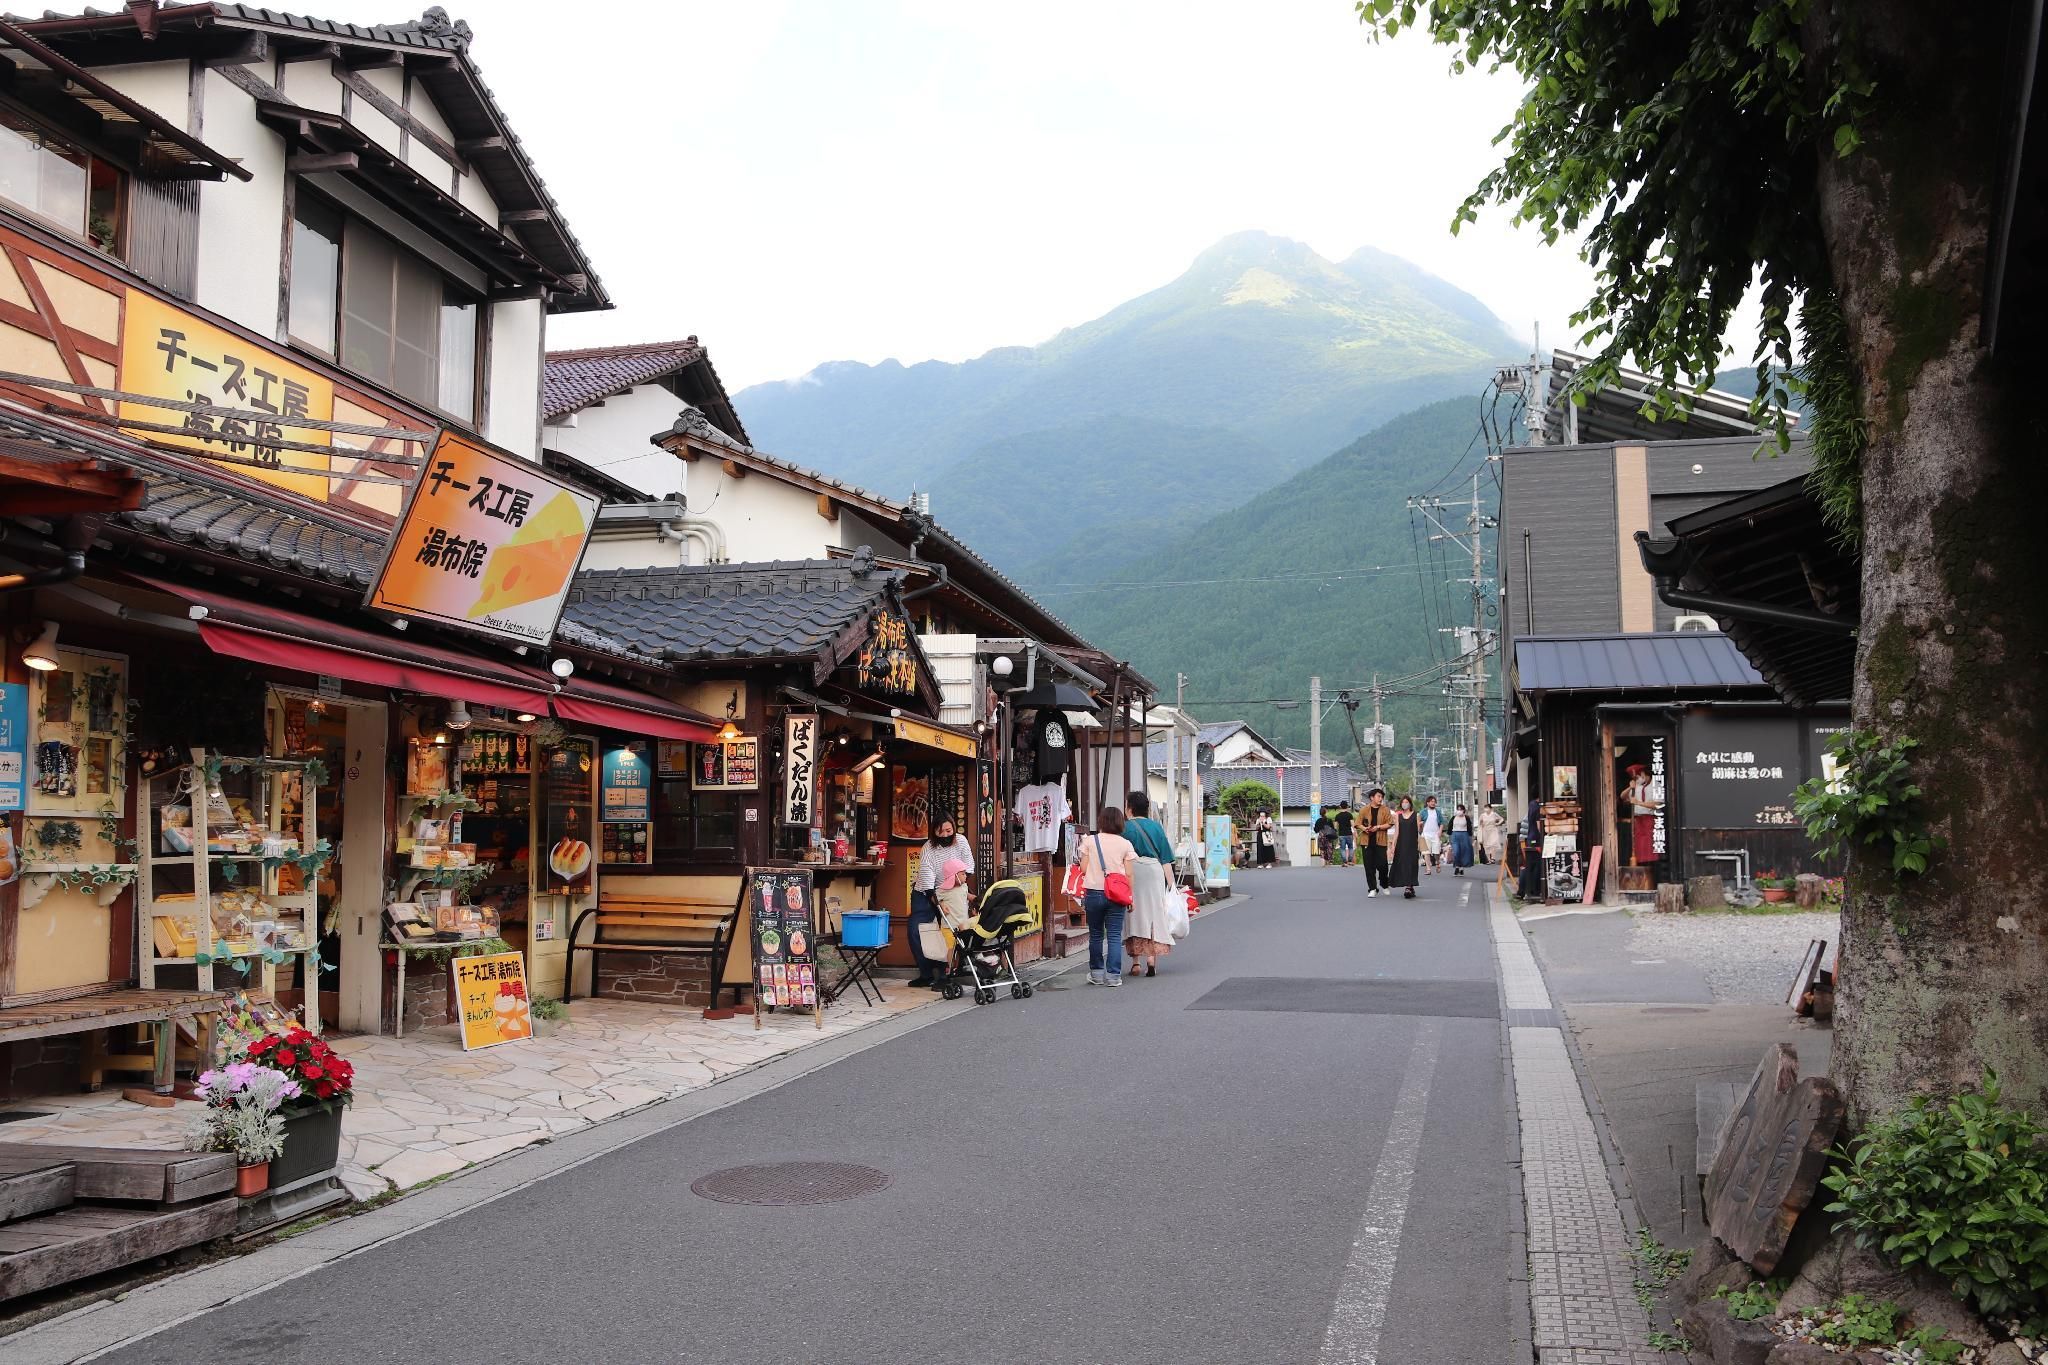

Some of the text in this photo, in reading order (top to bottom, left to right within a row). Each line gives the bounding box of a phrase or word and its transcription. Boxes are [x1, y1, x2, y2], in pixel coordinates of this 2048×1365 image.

[156, 328, 310, 419] チーズ工房
[430, 461, 534, 528] チーズ工房
[414, 526, 488, 579] 湯布院
[483, 614, 503, 628] Cheese
[504, 619, 525, 634] Factory
[1696, 751, 1755, 763] 食卓に感動
[791, 718, 814, 823] ばくだん焼
[1712, 766, 1784, 779] 胡麻は愛の種
[459, 960, 521, 983] チーズ工房 湯布院
[469, 992, 487, 1006] チーズ
[466, 1006, 494, 1022] まんじゅう
